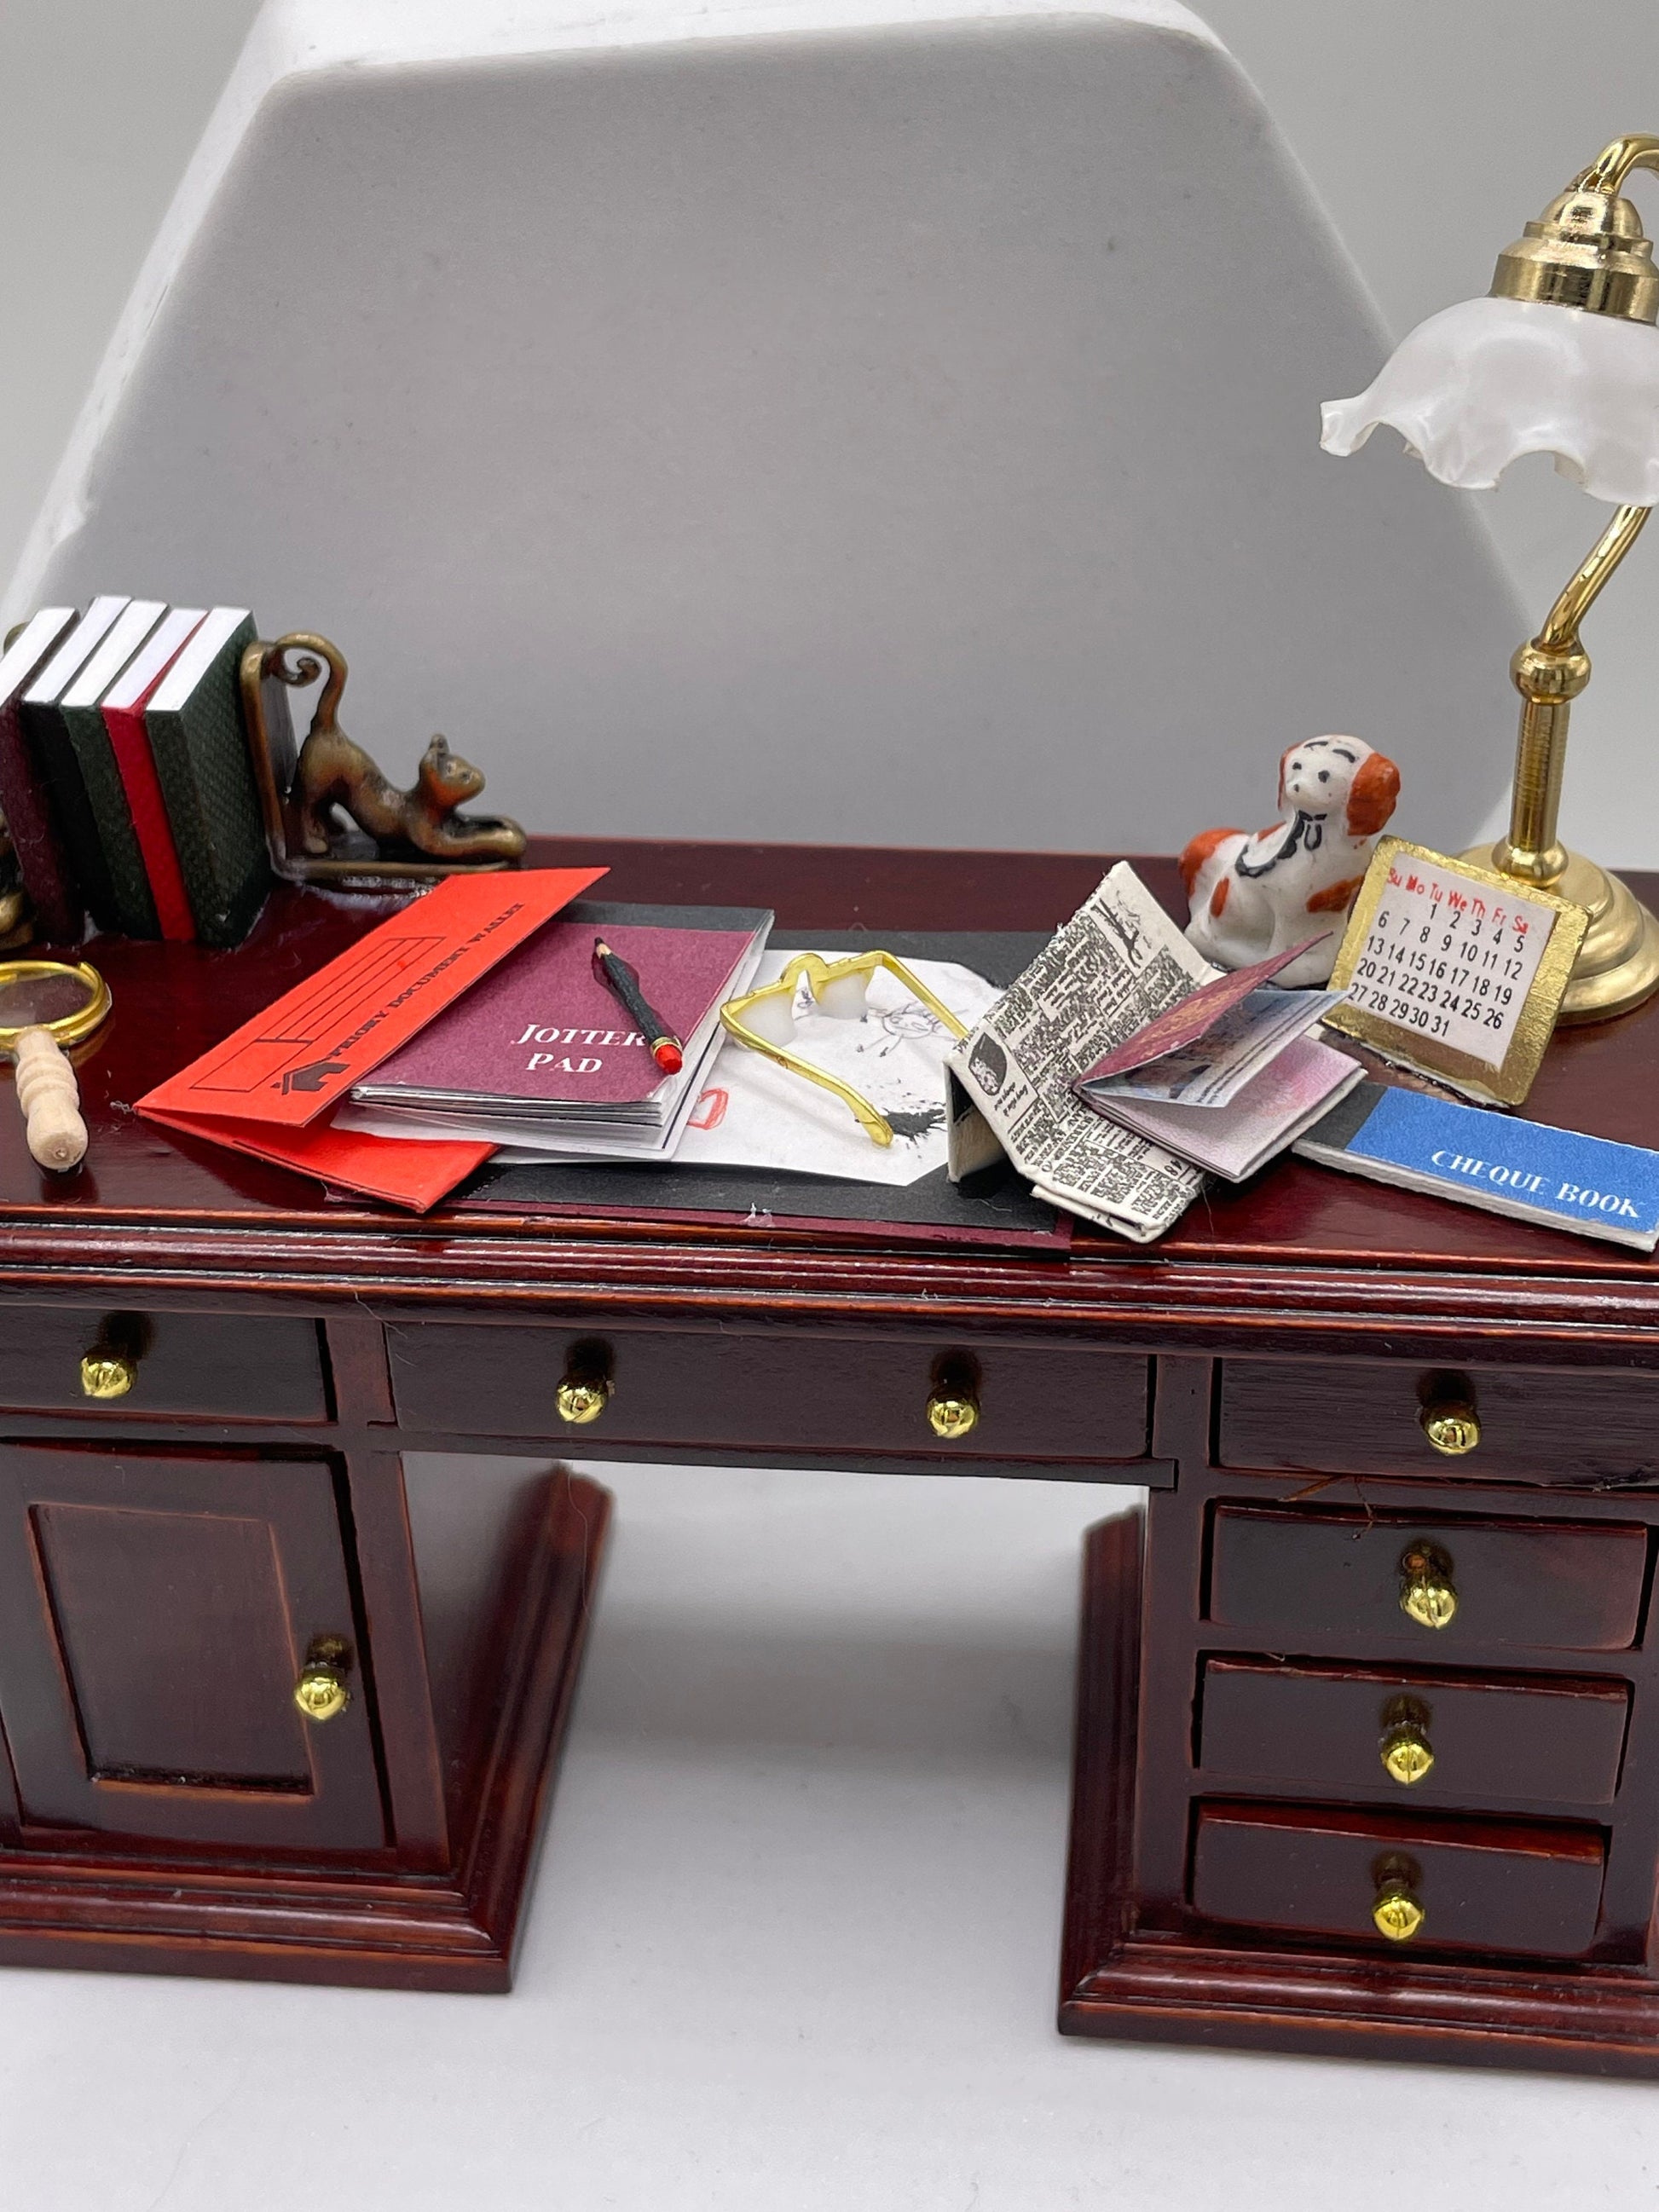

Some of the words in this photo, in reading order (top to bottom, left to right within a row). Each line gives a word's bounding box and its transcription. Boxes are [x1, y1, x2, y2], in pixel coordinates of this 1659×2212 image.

[1429, 883, 1443, 903] Tu
[1448, 891, 1468, 911] We
[1471, 898, 1486, 919] Th
[1492, 907, 1507, 926] Fr
[1512, 915, 1529, 935] Sa
[1430, 903, 1438, 920] 1
[1449, 910, 1460, 930] 2
[1471, 919, 1483, 936] 3
[1493, 928, 1504, 945] 4
[1514, 934, 1525, 953] 5
[386, 945, 471, 1009] DOCUMENT
[466, 902, 525, 944] WALLET
[1367, 935, 1385, 956] 13
[1388, 943, 1406, 964] 14
[1409, 950, 1427, 972] 15
[1429, 958, 1448, 979] 16
[1450, 967, 1470, 987] 17
[1471, 975, 1491, 996] 18
[1494, 985, 1512, 1006] 19
[1378, 910, 1390, 928] 6
[1399, 918, 1411, 935] 7
[1419, 926, 1431, 944] 8
[1441, 934, 1452, 951] 9
[1460, 941, 1478, 962] 10
[1482, 950, 1499, 970] 11
[1503, 958, 1523, 980] 12
[1348, 983, 1368, 1002] 27
[1368, 990, 1389, 1012] 28
[1389, 998, 1409, 1019] 29
[1408, 1007, 1429, 1028] 30
[1431, 1015, 1449, 1037] 31
[1357, 957, 1376, 978] 20
[1376, 966, 1396, 987] 21
[1398, 973, 1418, 996] 22
[1418, 981, 1438, 1002] 23
[1439, 990, 1460, 1012] 24
[1460, 999, 1481, 1020] 25
[1483, 1008, 1504, 1030] 26
[511, 1024, 646, 1046] JOTTER
[525, 1053, 603, 1073] PAD
[1431, 1151, 1551, 1195] CHEQUE
[1555, 1182, 1646, 1218] BOOK
